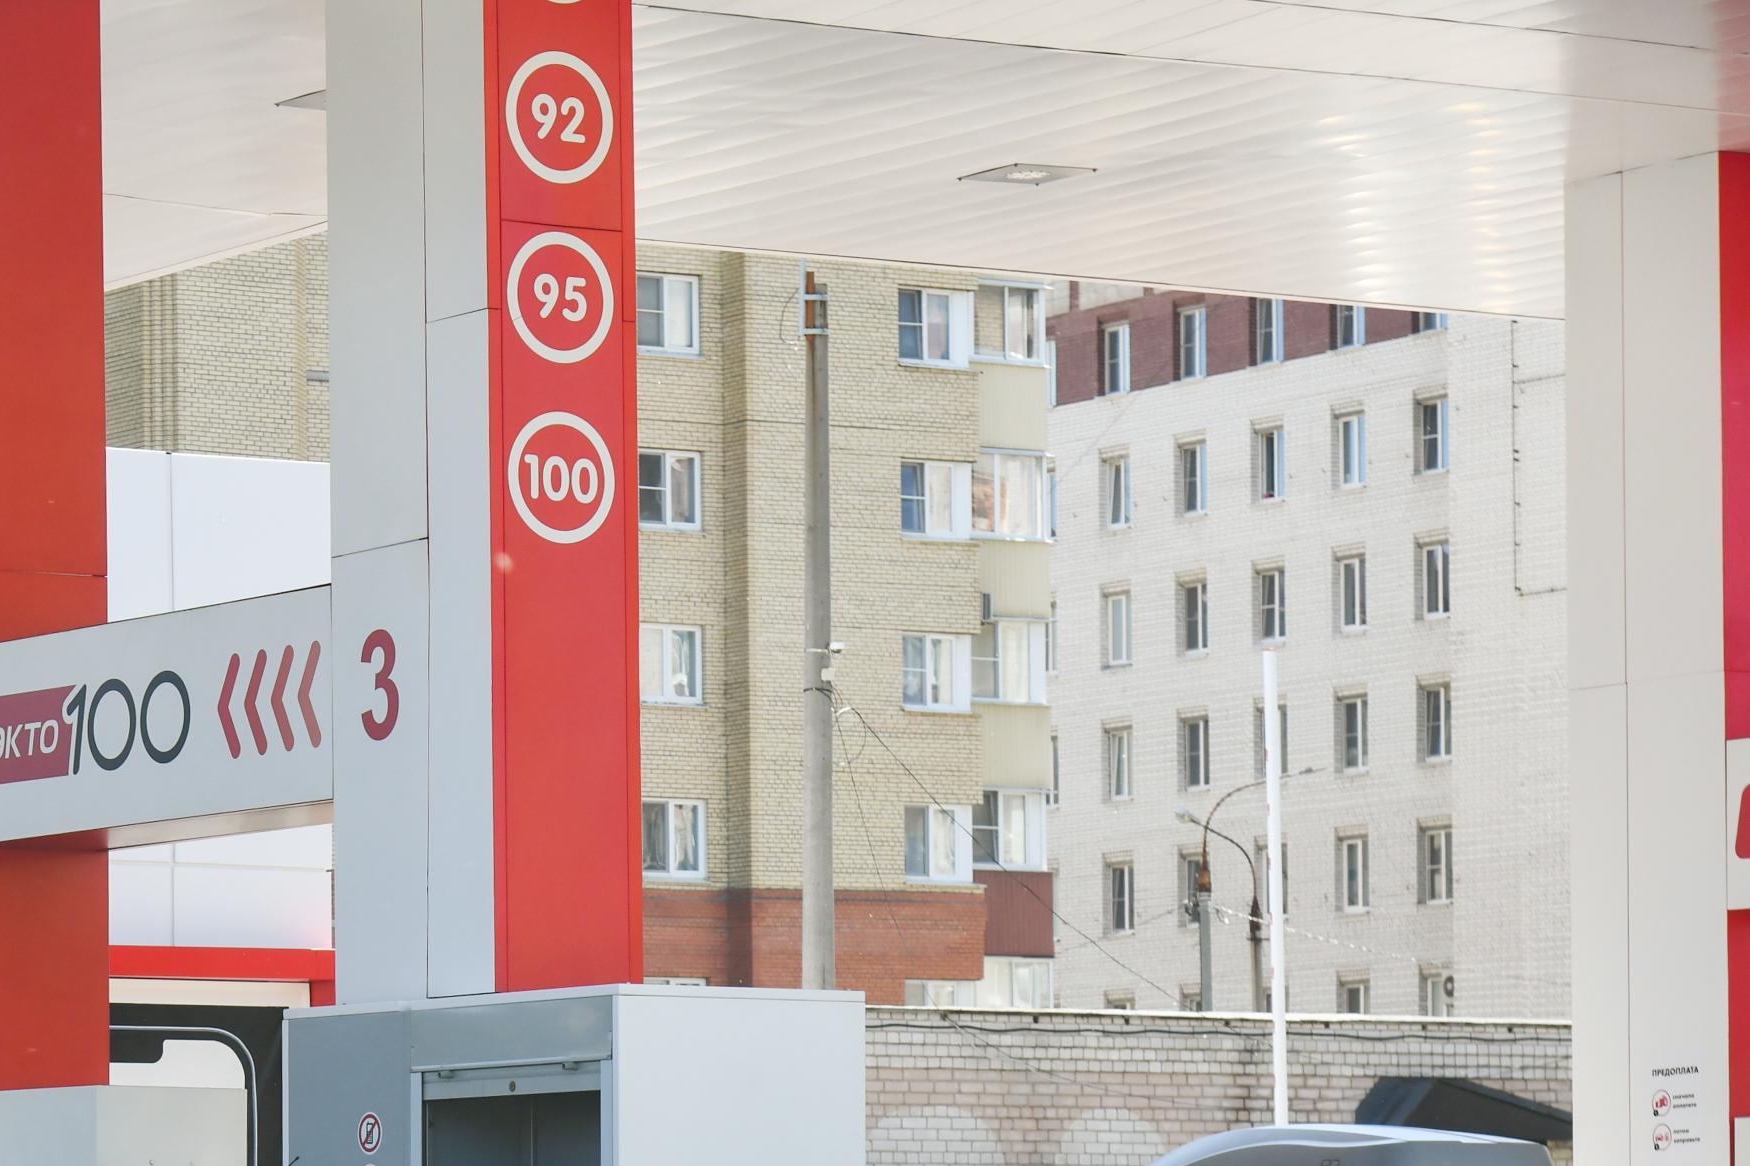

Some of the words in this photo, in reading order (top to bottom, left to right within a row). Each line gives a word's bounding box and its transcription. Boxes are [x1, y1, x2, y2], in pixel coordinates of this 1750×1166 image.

[531, 93, 586, 144] 92
[533, 273, 588, 322] 95
[524, 453, 599, 504] 100
[361, 629, 399, 741] 3
[66, 670, 191, 776] 100
[1652, 1066, 1699, 1077] ПРЕДОПЛАТА
